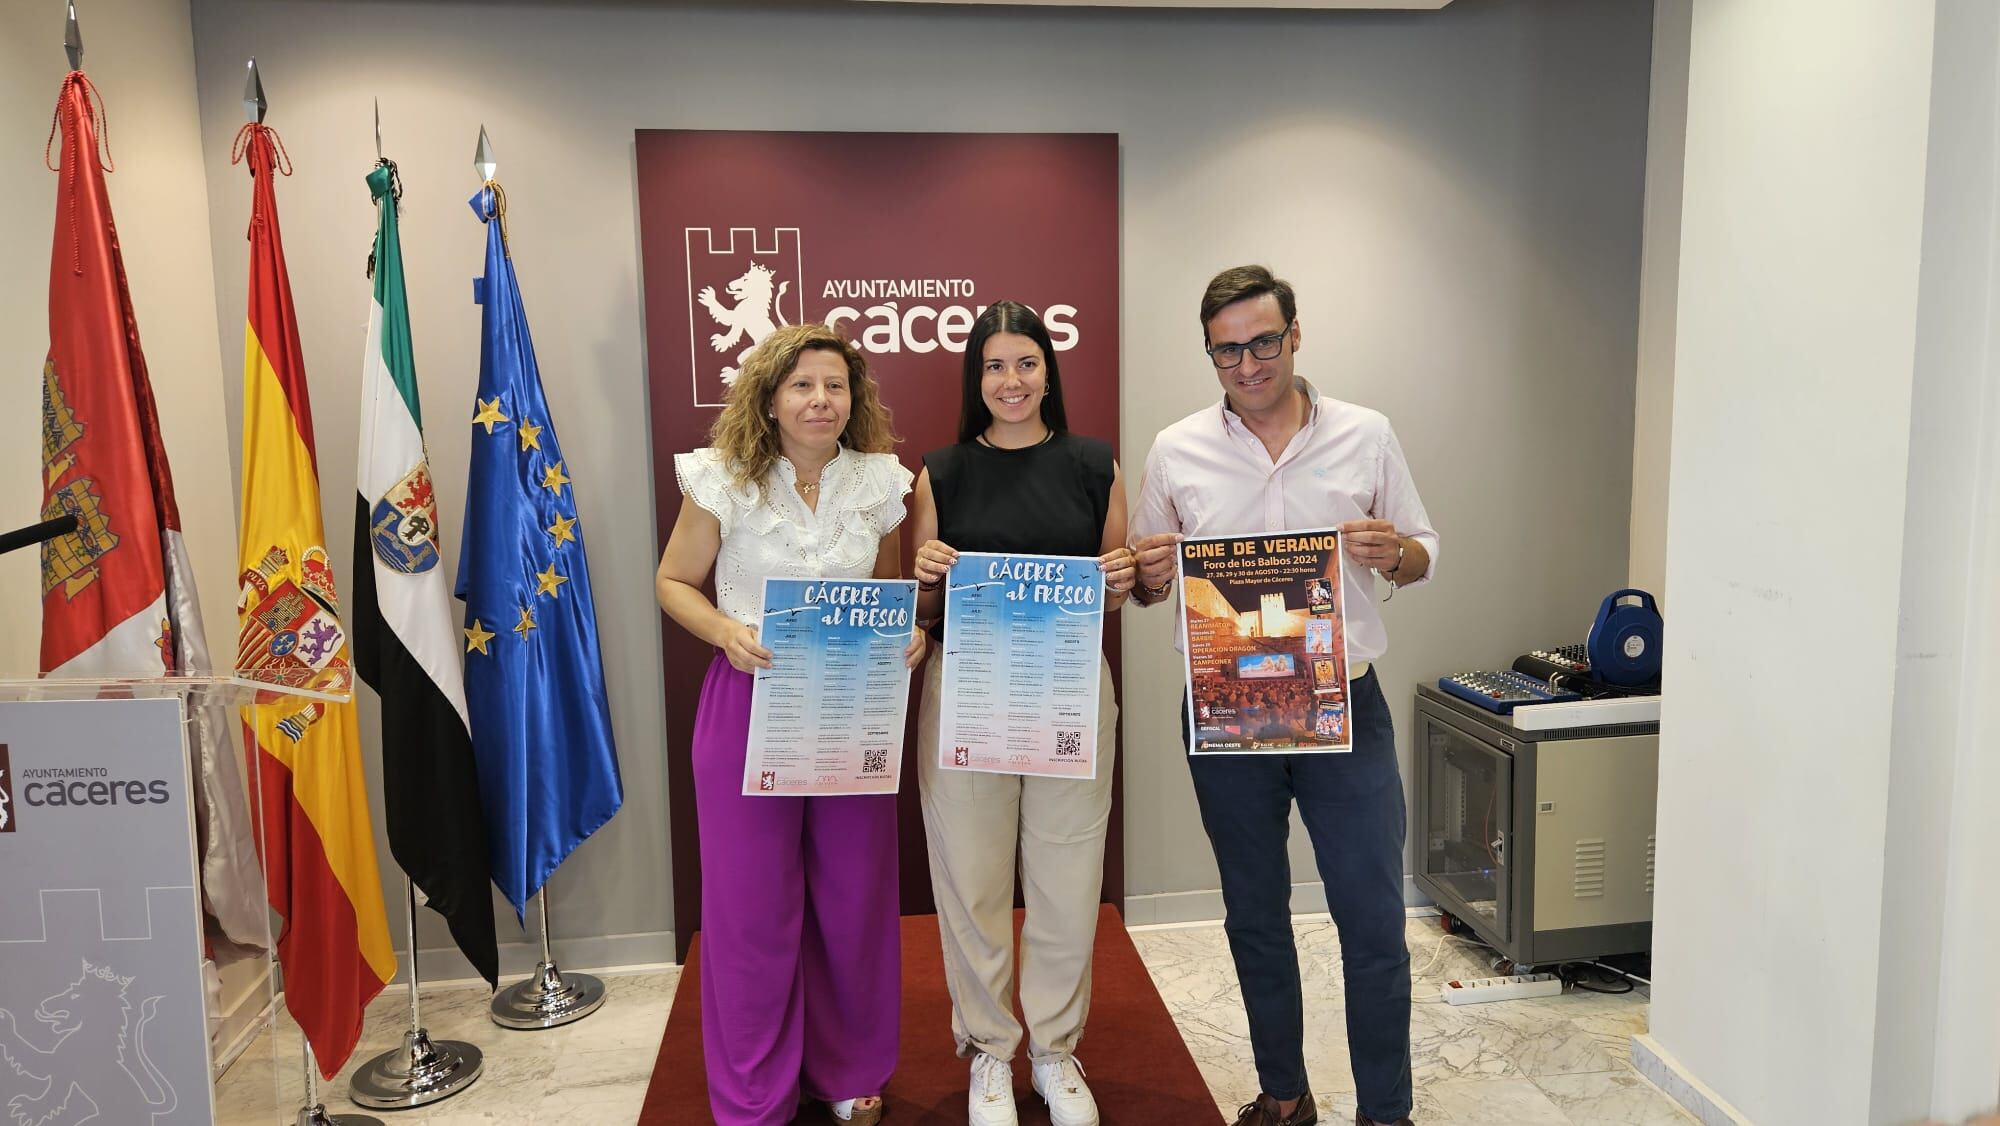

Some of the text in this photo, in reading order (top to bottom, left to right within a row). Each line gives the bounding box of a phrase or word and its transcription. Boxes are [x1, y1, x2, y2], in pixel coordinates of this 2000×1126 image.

[822, 279, 974, 298] AYUNTAMIENTO
[824, 301, 1079, 354] cáces
[1185, 536, 1335, 558] CINE DE VERANO
[988, 558, 1066, 583] CÁCERES
[1203, 554, 1318, 570] Foro de los Balbos 2024
[1254, 568, 1279, 576] AGOSTO
[805, 581, 881, 606] CÁCERES
[1006, 582, 1095, 604] al FRESCO
[821, 607, 908, 627] al FRESCO
[22, 767, 108, 779] AYUNTAMIENTO
[24, 779, 170, 807] cáceres
